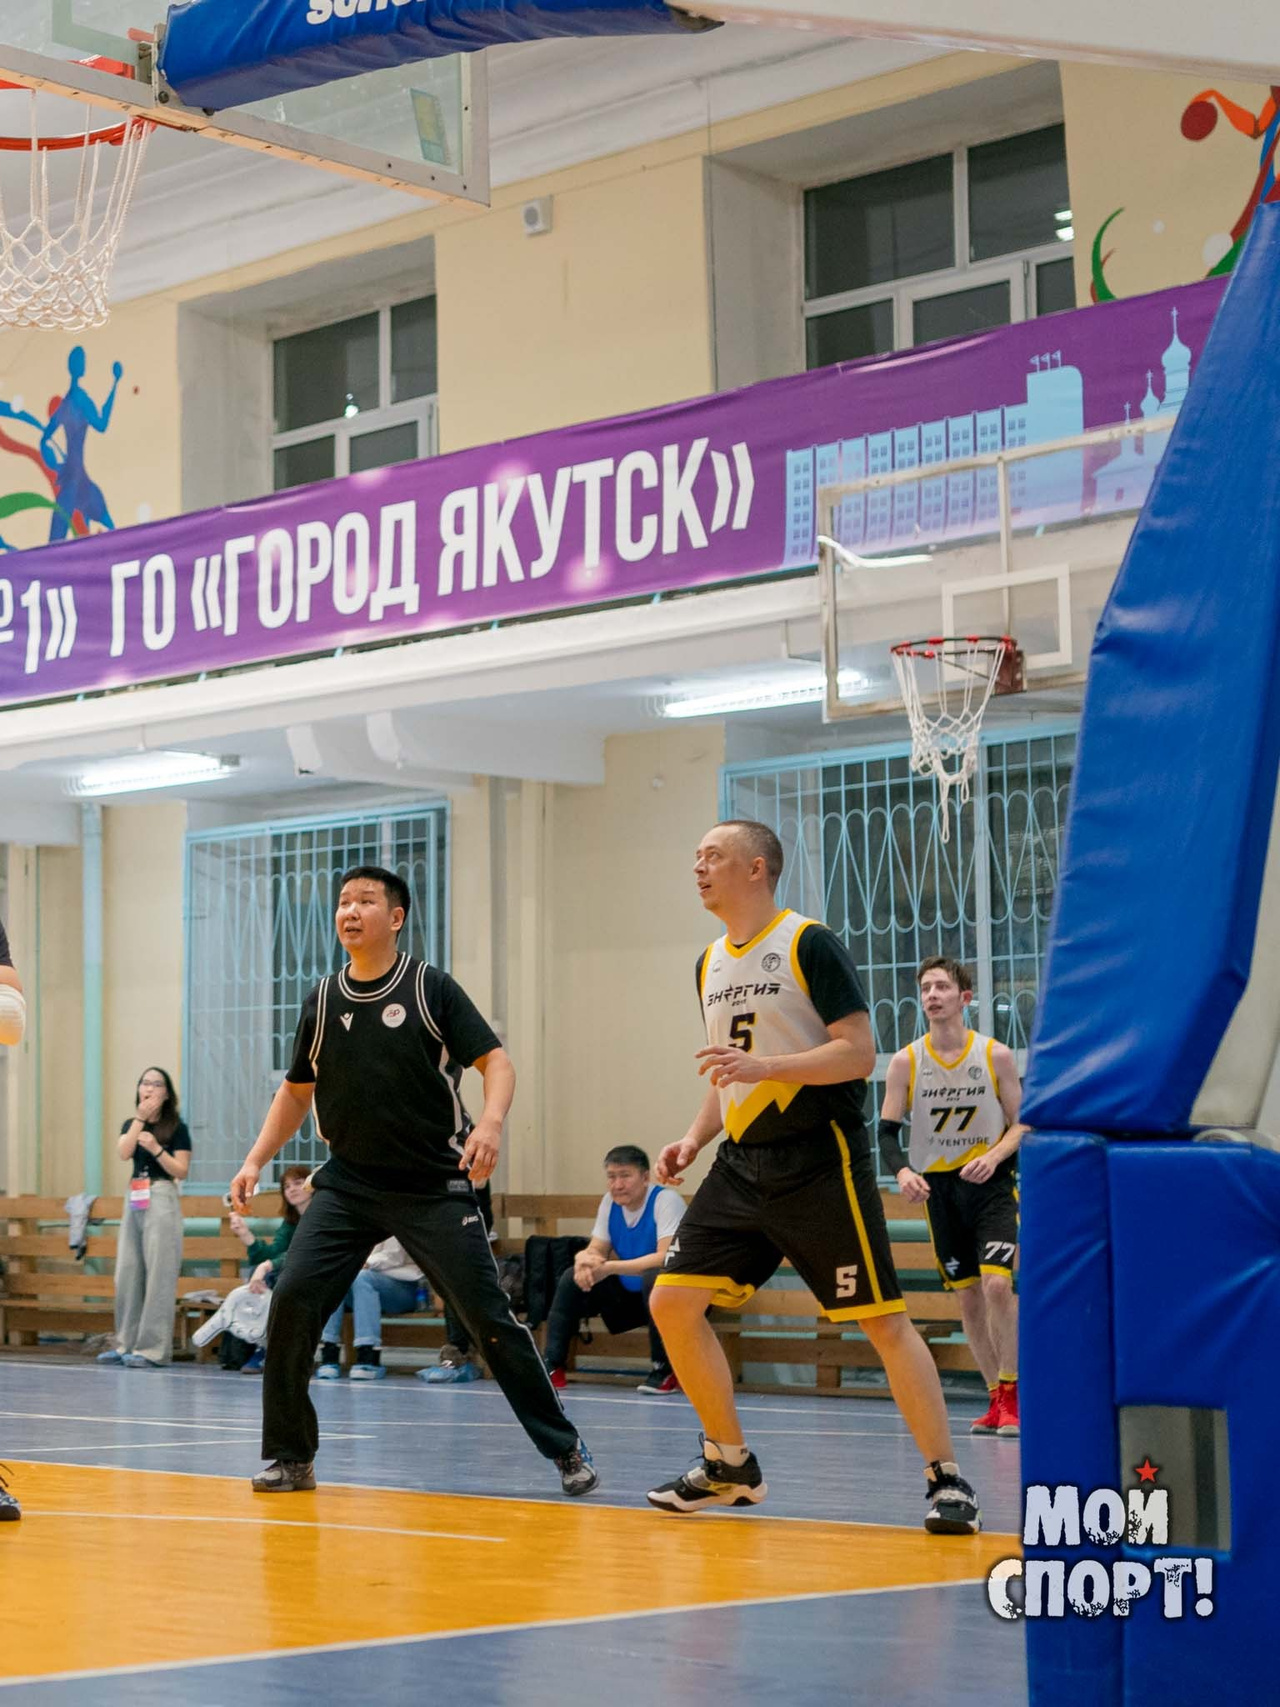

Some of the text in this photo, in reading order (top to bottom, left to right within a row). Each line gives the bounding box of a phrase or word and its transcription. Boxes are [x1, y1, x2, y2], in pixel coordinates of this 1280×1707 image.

[110, 554, 176, 657] ГО
[190, 500, 419, 636] «ГОРОД
[438, 437, 755, 596] ЯКУТСК»
[728, 1012, 757, 1053] 5
[930, 1105, 978, 1134] 77
[939, 1136, 991, 1147] VENTURE
[984, 1241, 1016, 1263] 77
[835, 1264, 858, 1298] 5
